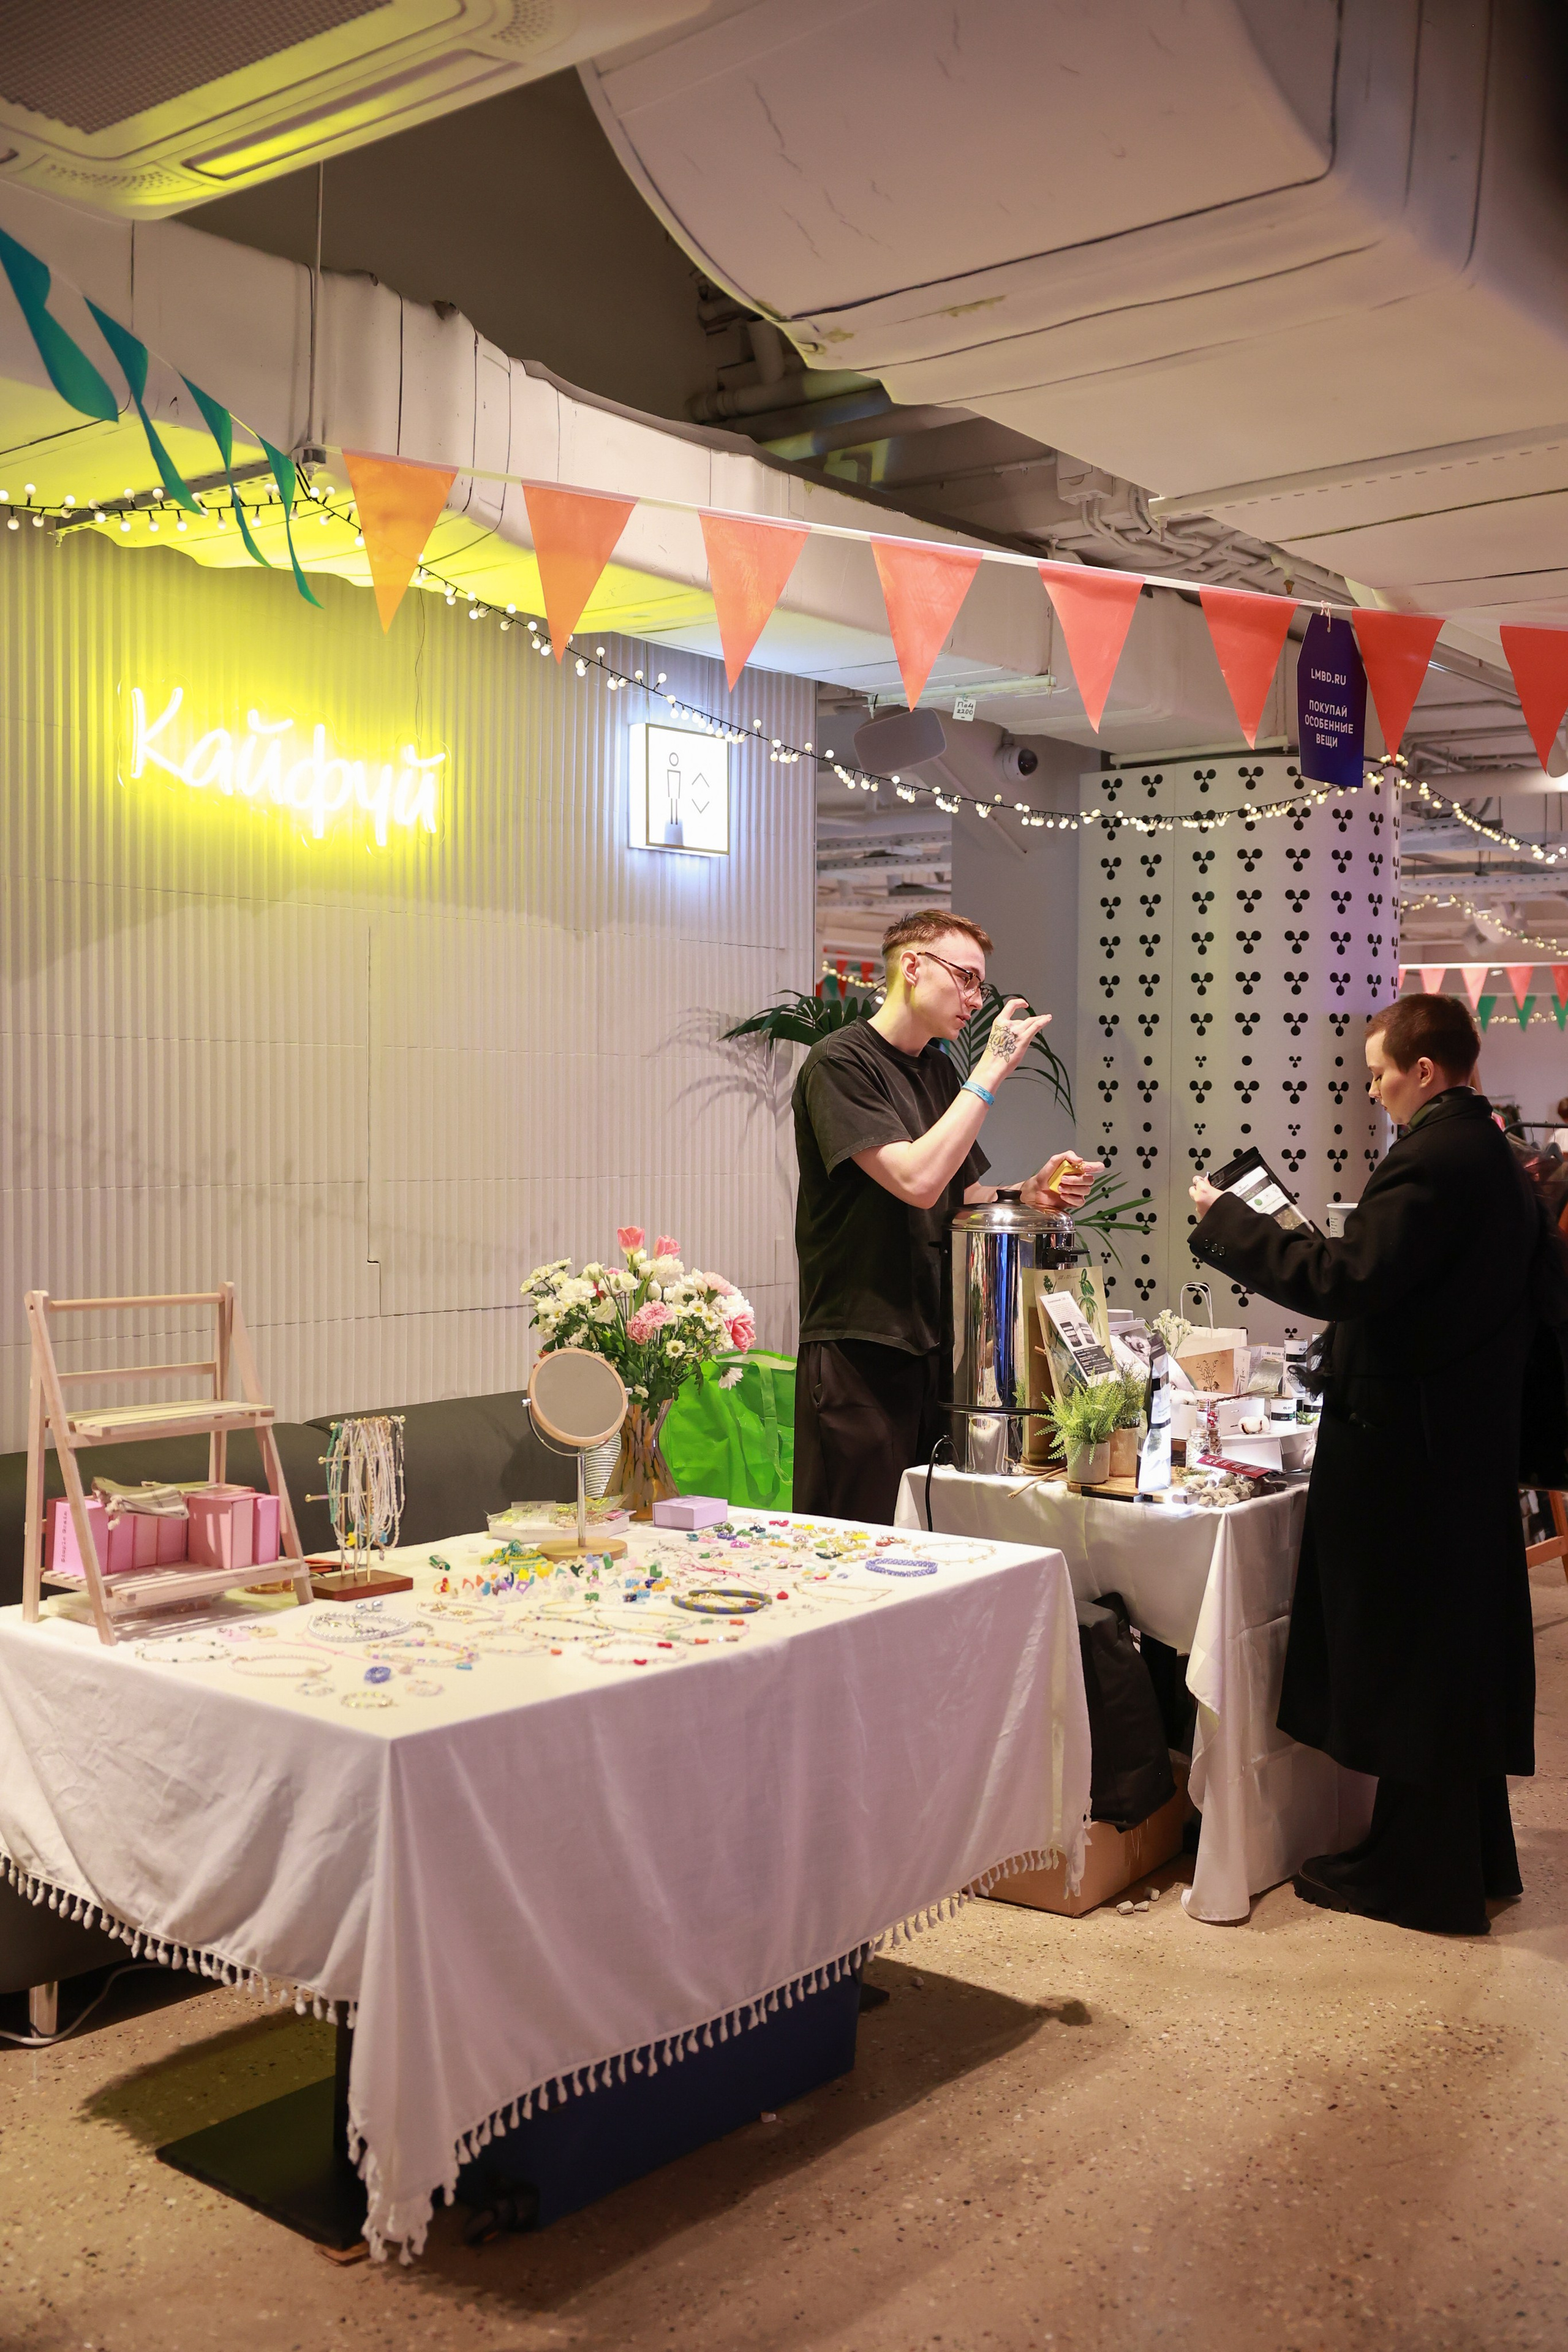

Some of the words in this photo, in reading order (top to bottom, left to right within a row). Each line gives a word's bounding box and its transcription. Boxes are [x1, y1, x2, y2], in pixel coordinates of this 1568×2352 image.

[1311, 668, 1347, 686] LMBD.RU
[1309, 699, 1348, 718] ПОКУПАЙ
[1305, 714, 1354, 734] ОСОБЕННЫЕ
[1316, 733, 1338, 748] ВЕЩИ
[130, 685, 446, 847] Кайфуй
